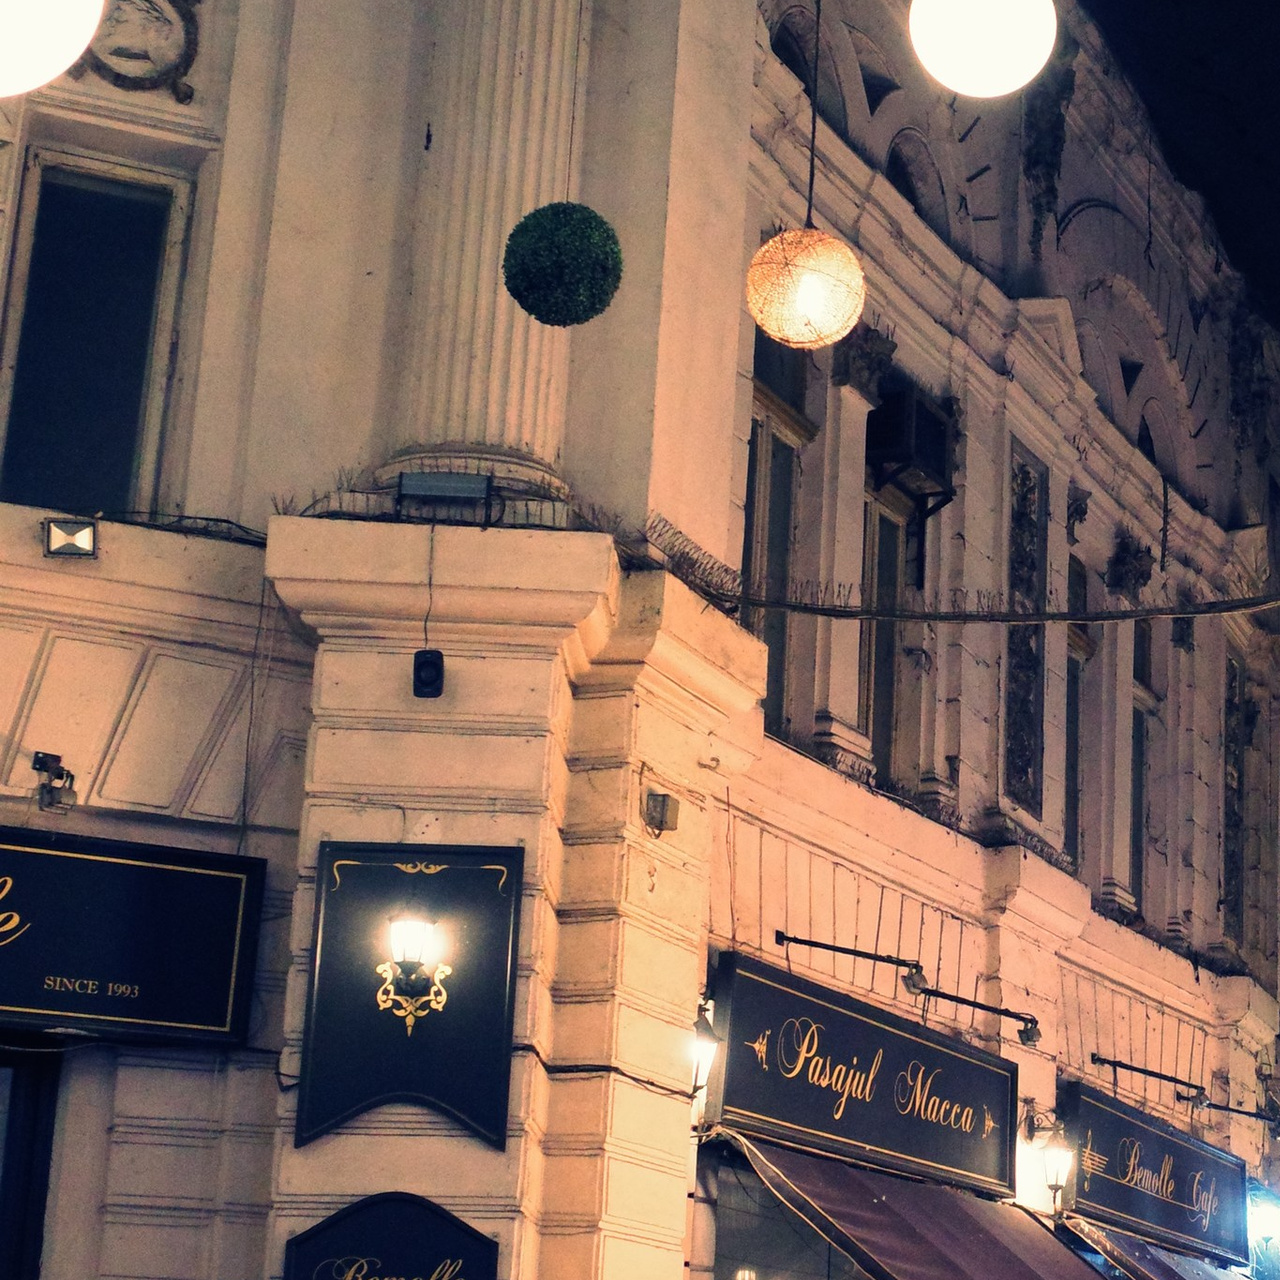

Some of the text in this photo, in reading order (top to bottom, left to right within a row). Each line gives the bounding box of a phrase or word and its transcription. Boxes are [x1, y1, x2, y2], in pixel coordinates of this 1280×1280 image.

[44, 976, 139, 998] SINCE 1993
[777, 1017, 977, 1132] Pasajul Macca
[1117, 1137, 1175, 1200] Bemolle
